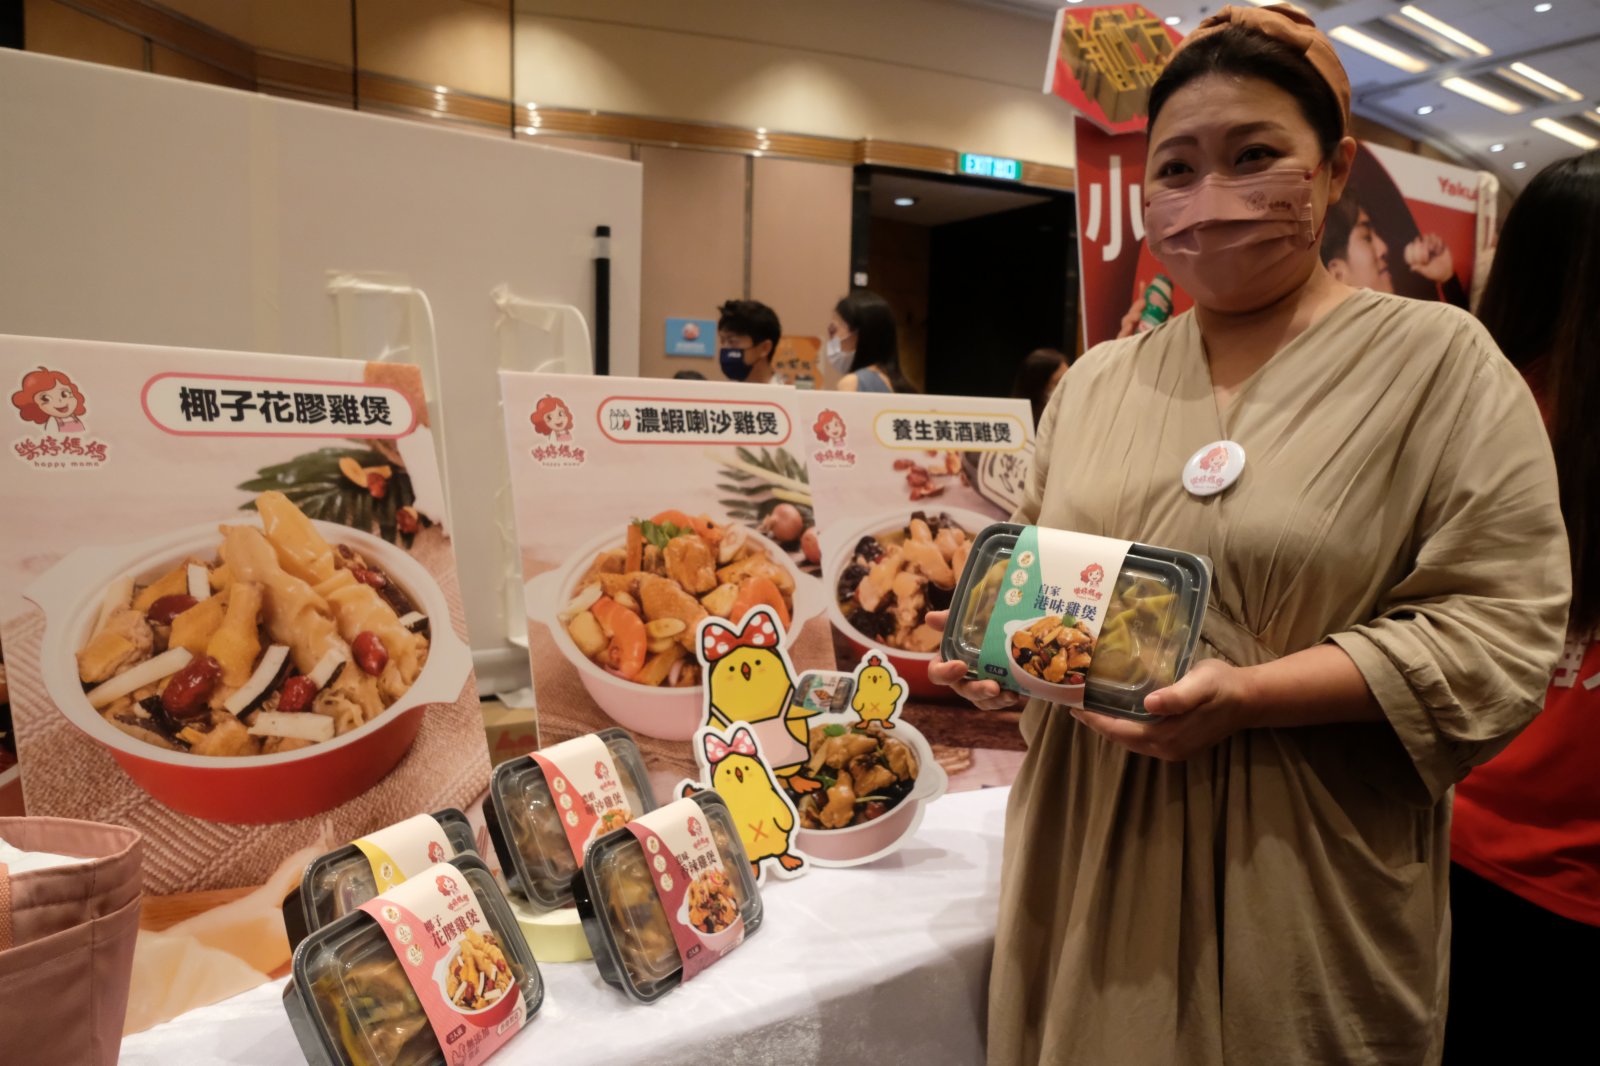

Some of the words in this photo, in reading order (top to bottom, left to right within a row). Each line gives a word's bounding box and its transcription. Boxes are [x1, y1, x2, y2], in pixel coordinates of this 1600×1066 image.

[1437, 175, 1479, 201] Yaku
[1085, 155, 1147, 262] 小
[179, 386, 393, 426] 椰子花膠雞煲
[634, 407, 779, 436] 濃蝦喇沙雞煲
[892, 418, 1012, 444] 養生黃酒雞煲
[34, 460, 66, 468] happy
[1033, 596, 1097, 622] 港味雞煲
[431, 908, 480, 949] 花膠雞煲
